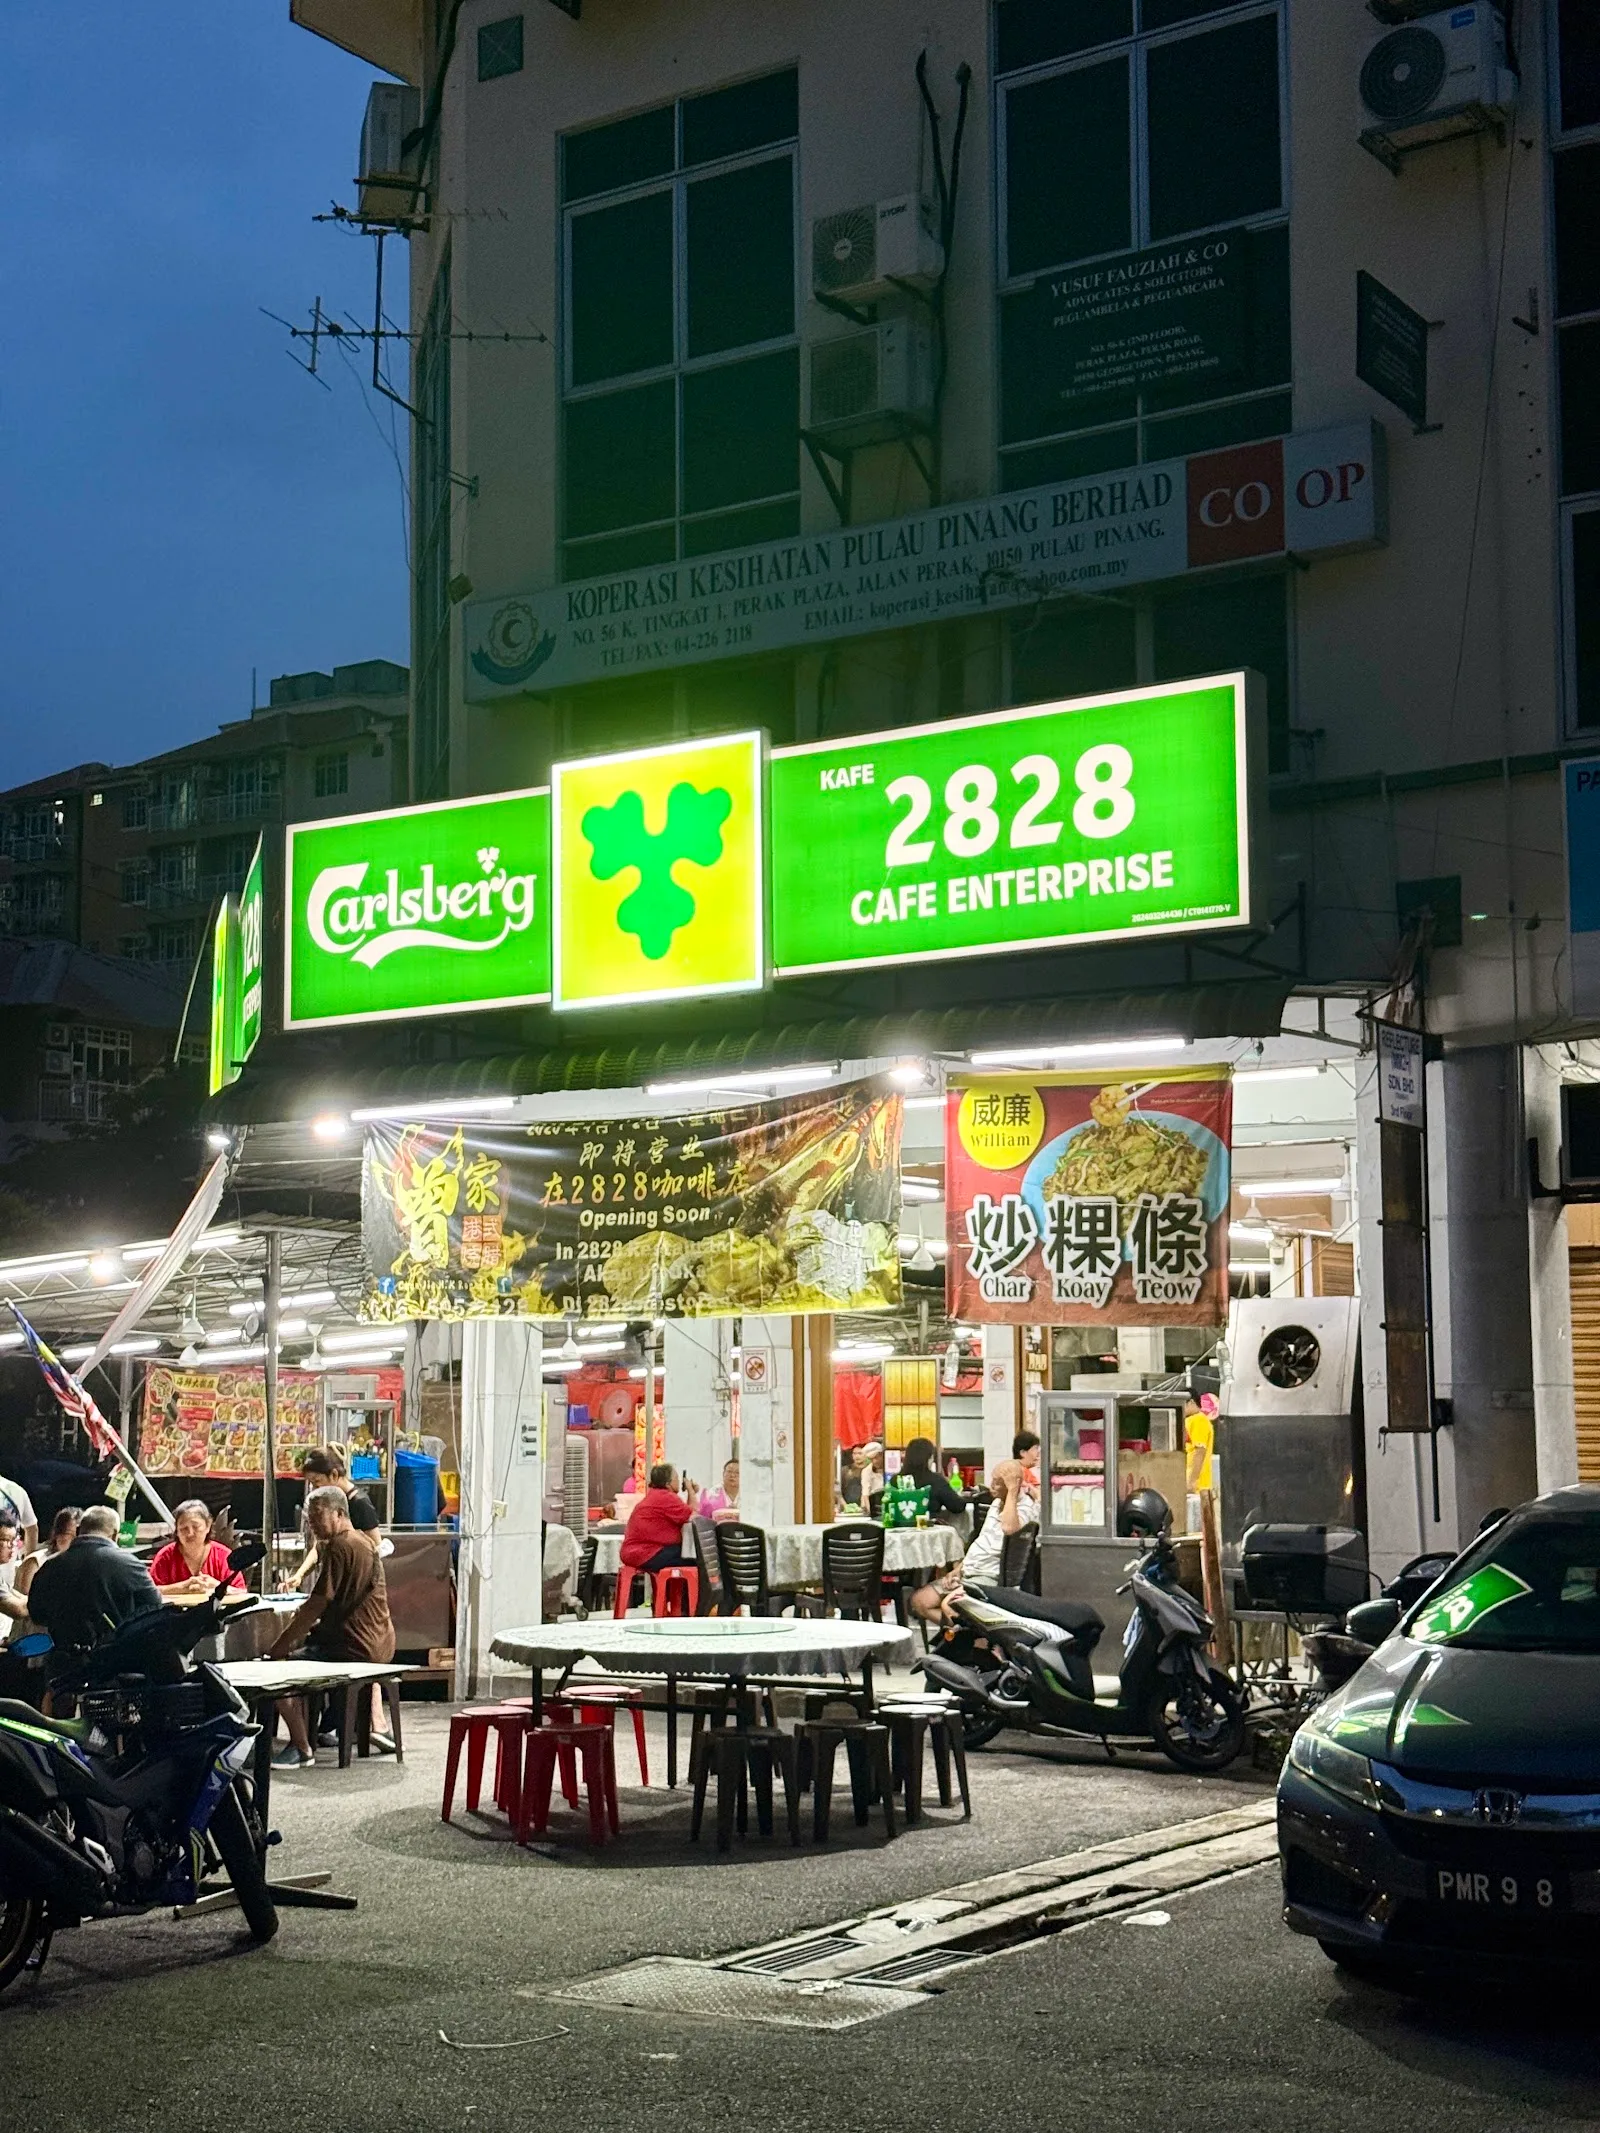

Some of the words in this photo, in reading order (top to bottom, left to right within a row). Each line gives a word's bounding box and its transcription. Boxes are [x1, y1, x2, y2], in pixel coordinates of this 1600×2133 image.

[1051, 272, 1104, 297] YUSUF
[1107, 252, 1180, 283] FAUZIAH
[1185, 249, 1198, 264] &
[1203, 242, 1228, 260] CO
[1064, 286, 1130, 309] ADVOCATES
[1133, 282, 1141, 292] &
[1144, 265, 1213, 288] SOLICITORS
[1053, 301, 1129, 328] PEGUAMBELA
[1132, 297, 1140, 307] &
[1143, 278, 1224, 304] PEGUAMCARA
[1199, 481, 1272, 528] CO
[1296, 461, 1366, 510] OP
[567, 571, 678, 622] KOPERASI
[690, 542, 831, 599] KESIHATAN
[843, 522, 925, 569] PULAU
[938, 499, 1038, 550] PINANG
[1051, 472, 1173, 528] BERHAD
[645, 607, 709, 635] TINGKAT
[734, 590, 786, 617] PERAK
[856, 568, 910, 598] JALAN
[1031, 532, 1086, 561] PULAU
[1094, 518, 1165, 549] PINANG.
[819, 763, 875, 791] KAFE
[884, 743, 1136, 868] 2828
[851, 882, 938, 926] CAFE
[948, 850, 1174, 912] ENTERPRISE
[307, 862, 537, 962] Carlsberg
[972, 1094, 1031, 1127] 威廉
[579, 1135, 705, 1171] 即将营业
[970, 1132, 1031, 1147] William
[579, 1207, 658, 1230] Opening
[663, 1205, 711, 1224] Soon
[971, 1200, 1202, 1275] 炒粿條
[556, 1242, 573, 1260] In
[984, 1277, 1027, 1297] Char
[1056, 1278, 1110, 1303] Koay
[1137, 1278, 1196, 1298] Teow
[1438, 1871, 1490, 1903] PMR
[1501, 1876, 1518, 1904] 9
[1536, 1879, 1553, 1907] 8
